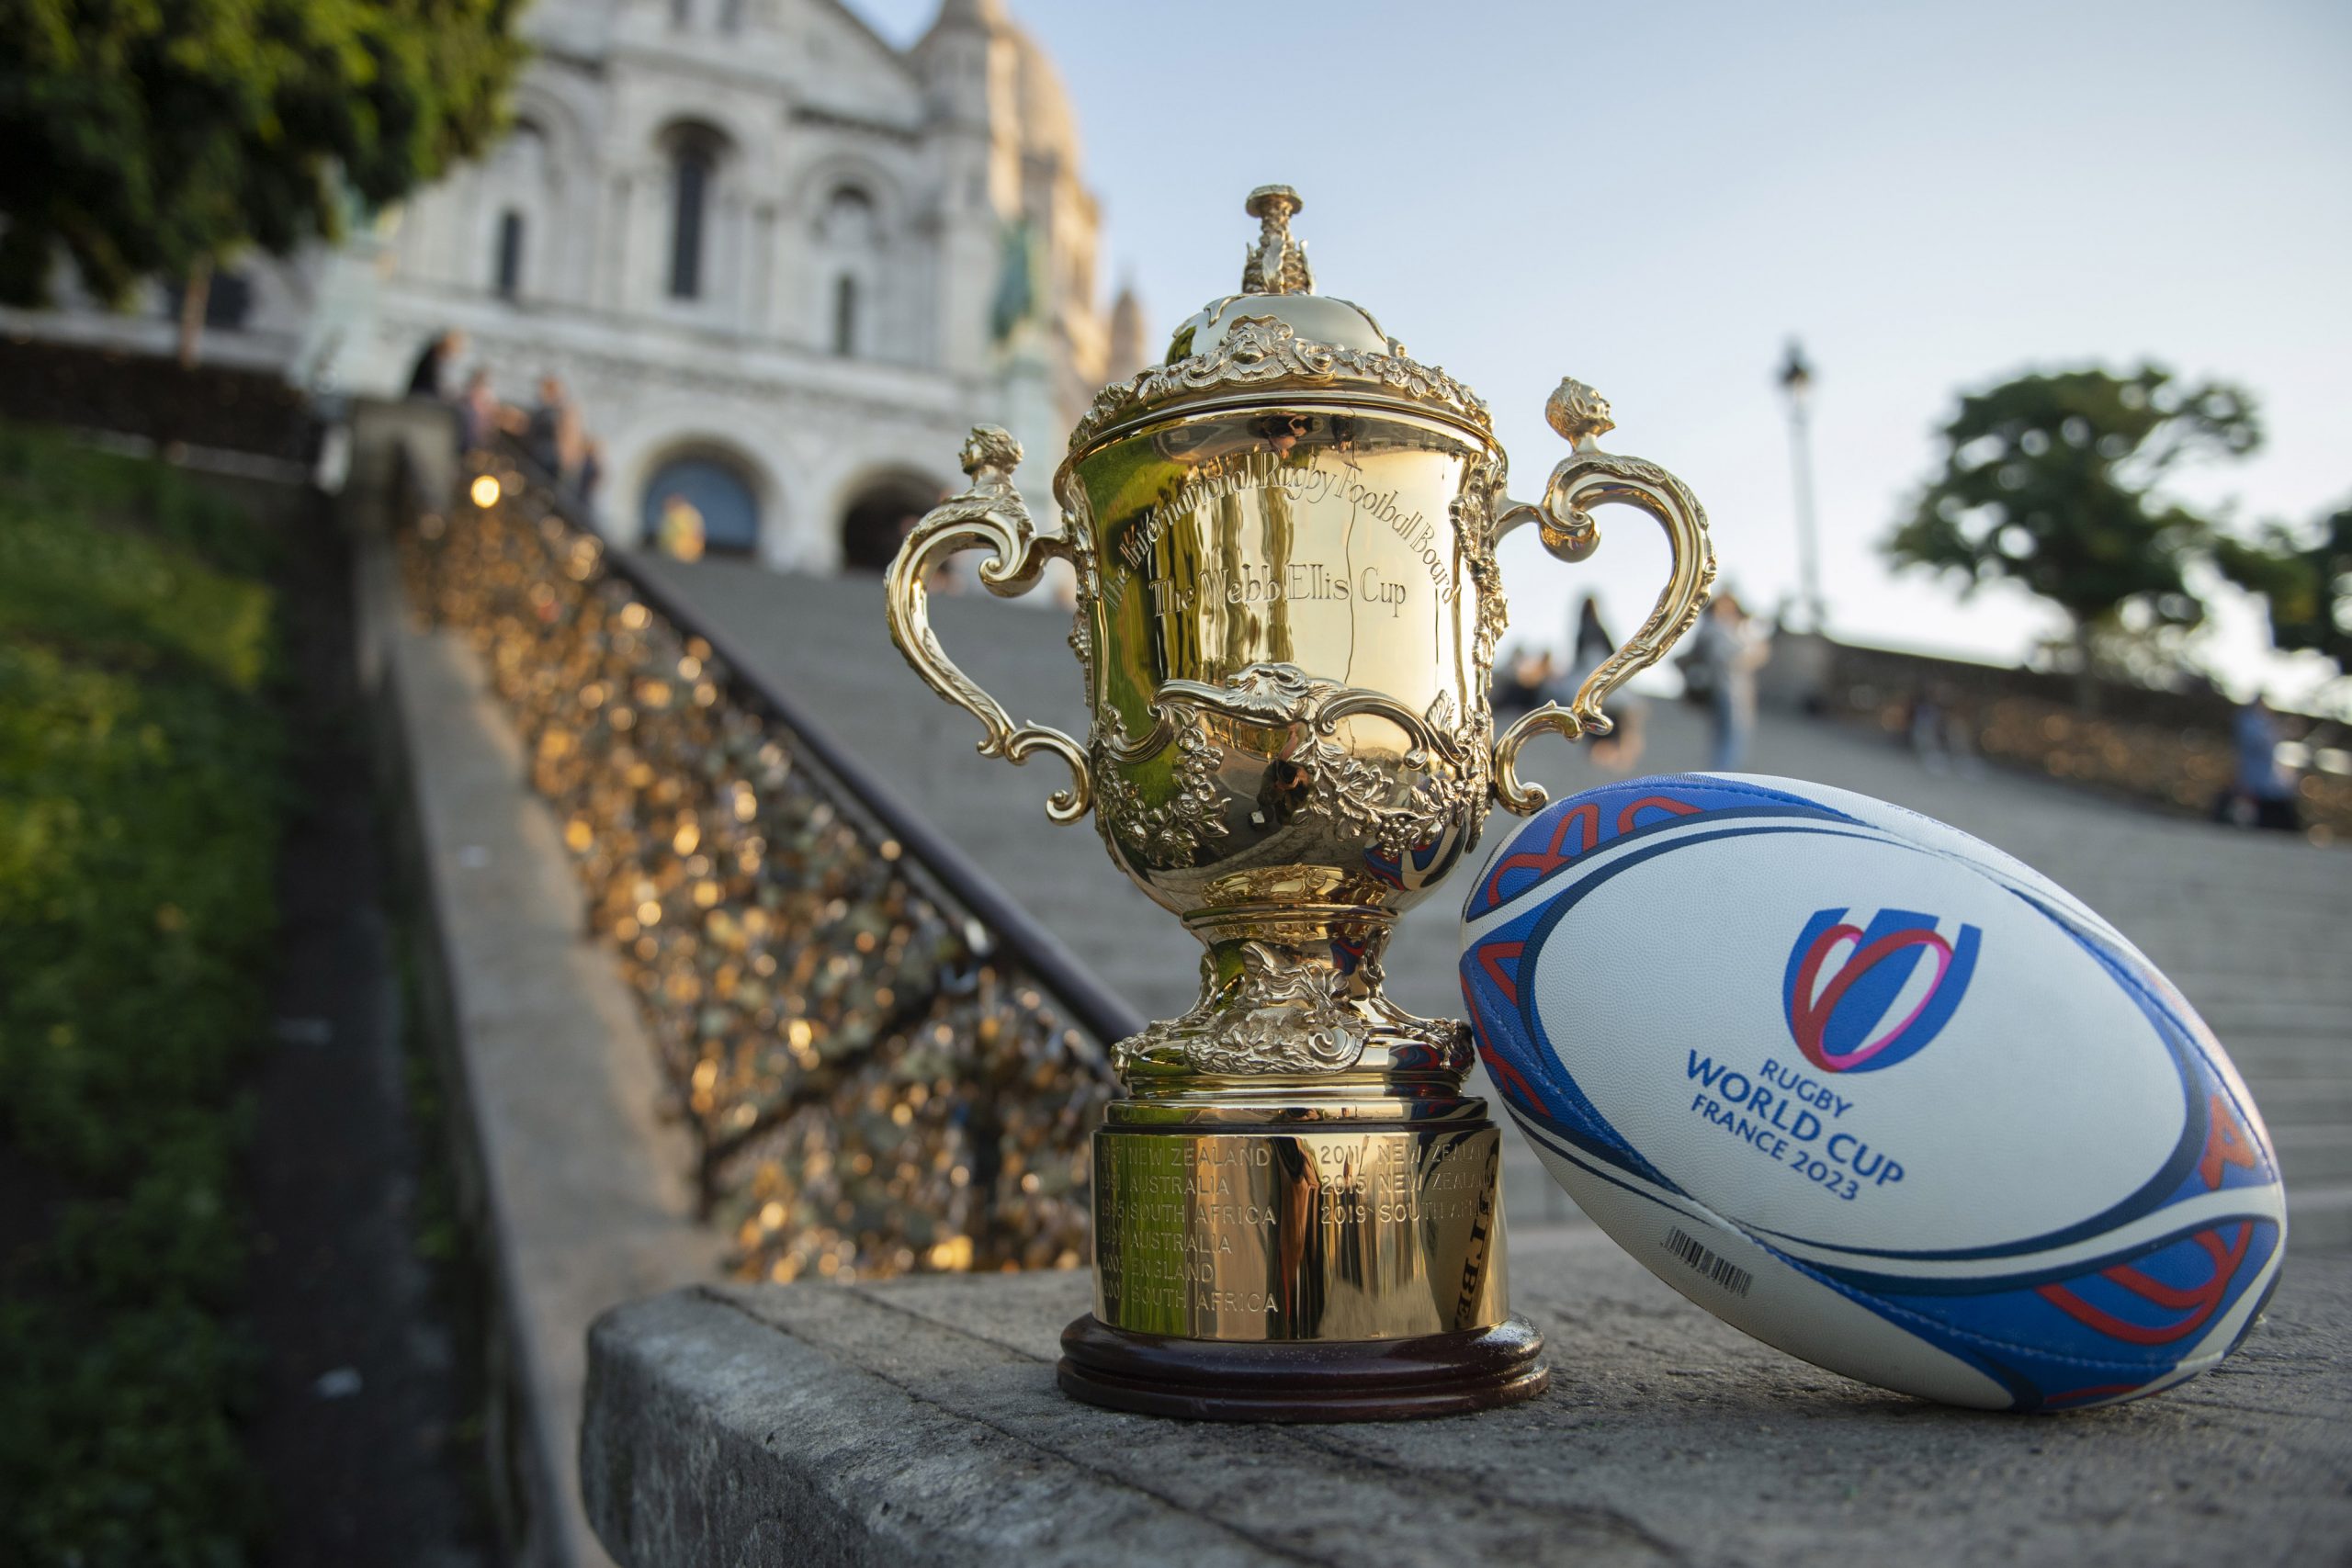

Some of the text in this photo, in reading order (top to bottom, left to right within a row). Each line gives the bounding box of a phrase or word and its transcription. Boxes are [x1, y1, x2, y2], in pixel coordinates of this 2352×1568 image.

[1119, 454, 1253, 570] International
[1257, 451, 1337, 504] Rugby
[1333, 461, 1423, 542] Football
[1409, 522, 1462, 604] Board
[1148, 563, 1407, 618] The Webb Ellis Cup
[1758, 1057, 1854, 1119] RUGBY
[1687, 1048, 1905, 1187] WORLD CUP
[1128, 1147, 1163, 1167] NEW
[1170, 1146, 1272, 1168] ZEALAND
[1320, 1142, 1492, 1165] 2011 NEW ZEALAN
[1690, 1093, 1860, 1201] FRANCE 2023
[1129, 1175, 1230, 1196] AUSTRALIA
[1320, 1170, 1493, 1195] 2015 NEW ZEALAN
[1129, 1202, 1185, 1223] SOUTH
[1194, 1203, 1278, 1225] AFRICA
[1320, 1204, 1367, 1224] 2019
[1378, 1201, 1444, 1224] SOUTH
[1130, 1232, 1233, 1255] AUSTRALIA
[1131, 1257, 1215, 1283] ENGLAND
[1103, 1278, 1280, 1314] 200 SOUTH AFRICA
